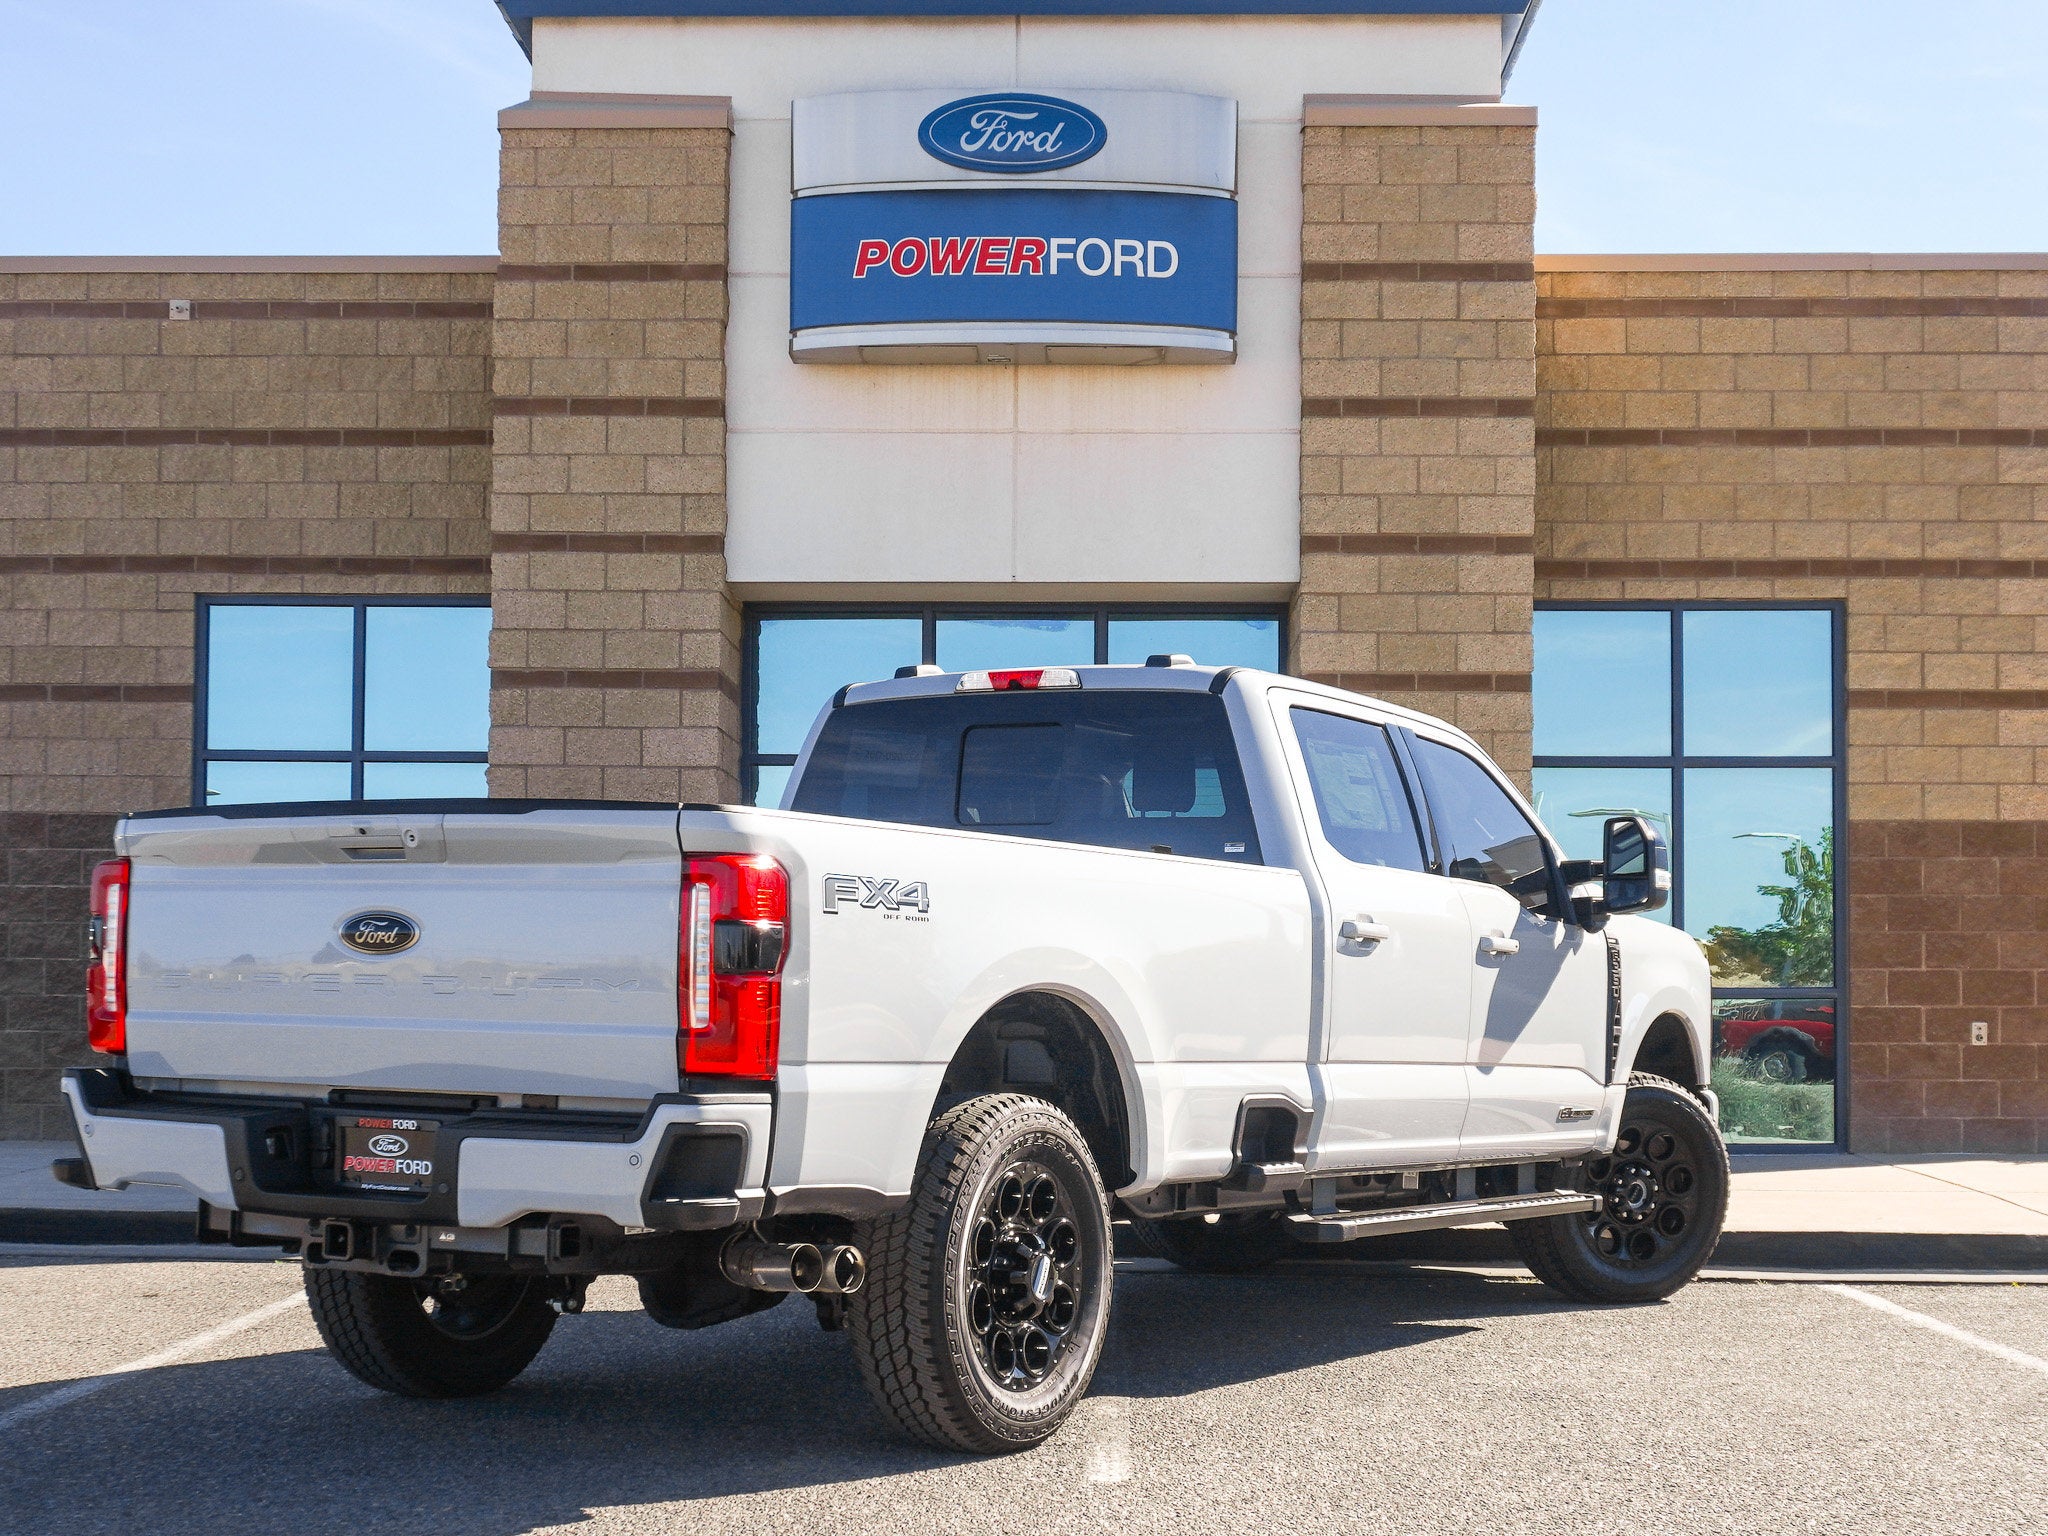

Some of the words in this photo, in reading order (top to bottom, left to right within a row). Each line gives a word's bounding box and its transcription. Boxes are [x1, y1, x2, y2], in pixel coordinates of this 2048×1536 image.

[960, 110, 1064, 153] Ford
[822, 872, 930, 914] FX4
[355, 920, 399, 943] Ford
[376, 1138, 401, 1153] Ford
